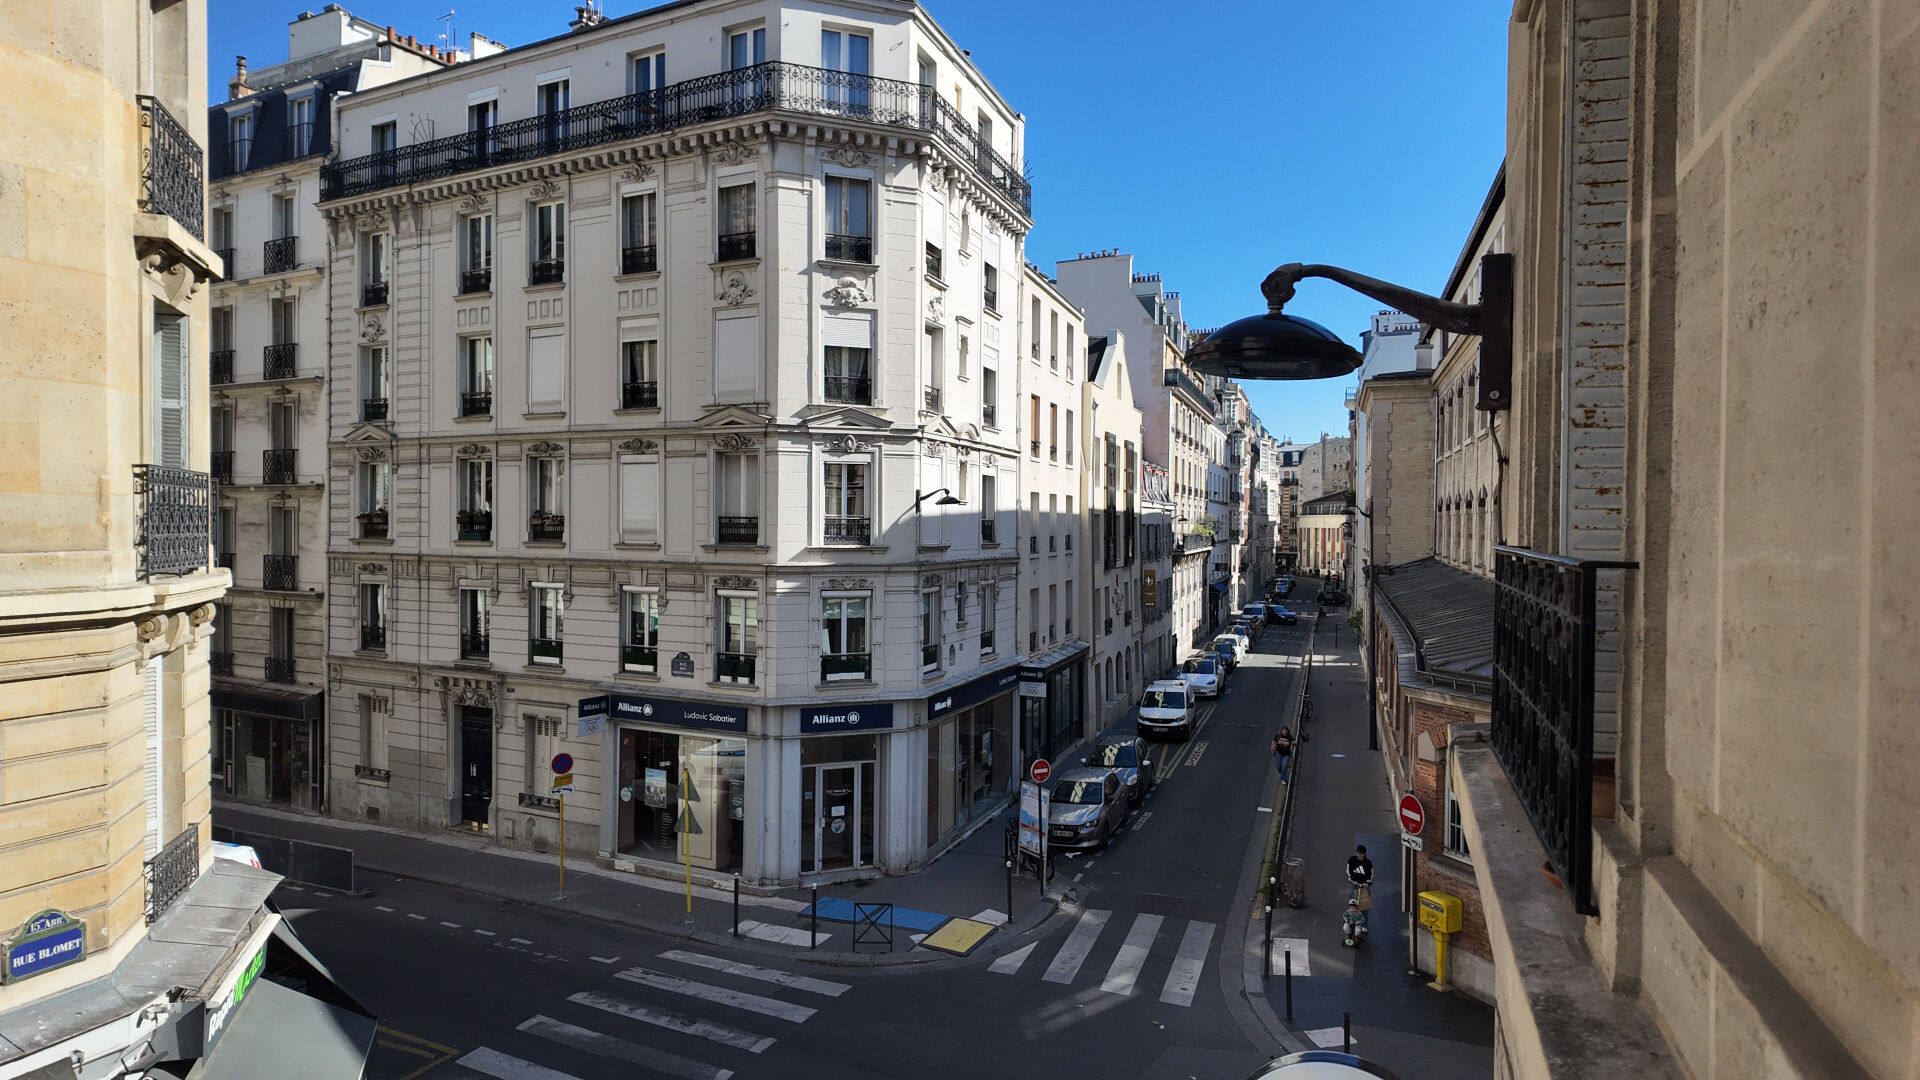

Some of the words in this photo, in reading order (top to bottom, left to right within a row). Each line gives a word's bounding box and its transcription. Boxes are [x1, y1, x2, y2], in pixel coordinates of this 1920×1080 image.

[583, 702, 601, 711] Allianz
[617, 702, 643, 713] Allianz
[683, 710, 707, 721] Ludovic
[708, 713, 736, 724] Sabatier
[812, 714, 846, 725] Allianz
[13, 952, 36, 968] RUE
[38, 938, 82, 960] BLOMET
